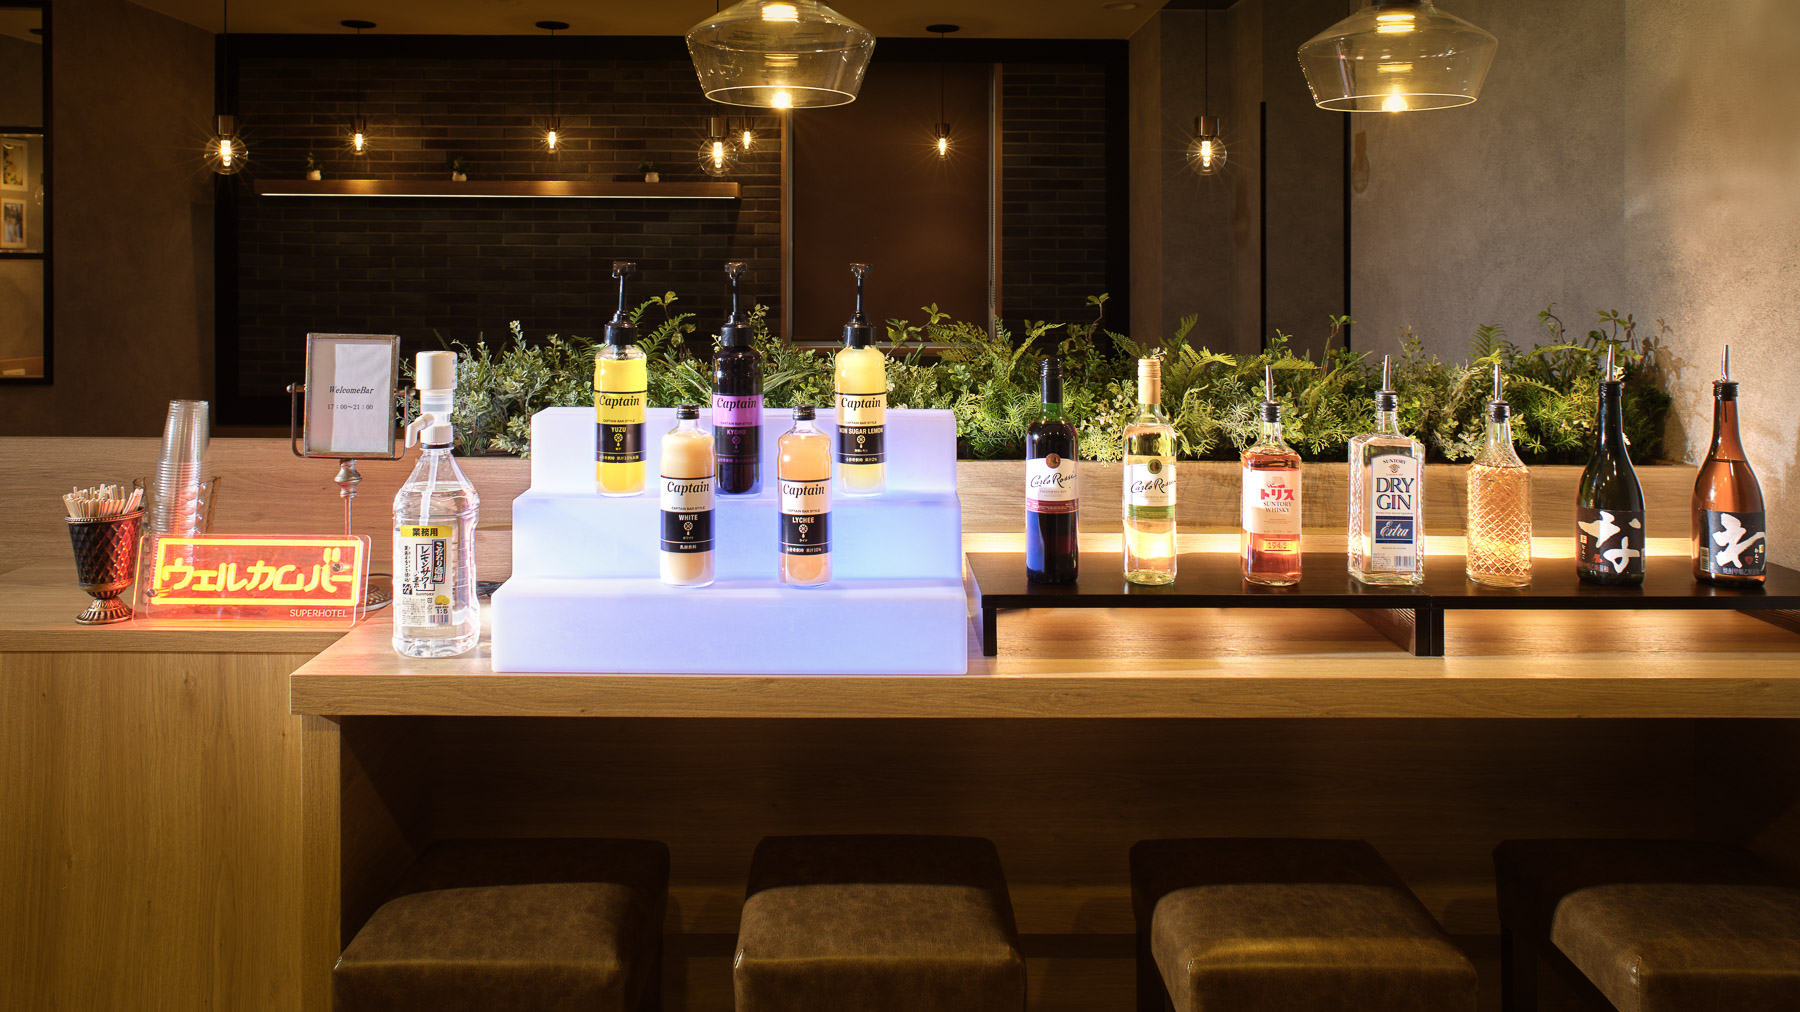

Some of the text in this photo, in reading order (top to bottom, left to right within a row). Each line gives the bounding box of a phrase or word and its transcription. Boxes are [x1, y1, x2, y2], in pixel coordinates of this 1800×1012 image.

[329, 386, 374, 394] WelcomeBar
[599, 395, 640, 409] Captain
[716, 398, 757, 411] Captain
[841, 398, 881, 411] Captain
[1030, 470, 1077, 489] Carlo Rossi
[1376, 477, 1415, 494] DRY
[667, 481, 709, 496] Captain
[783, 484, 824, 498] Captain
[1130, 480, 1153, 494] Carlo
[1260, 488, 1295, 501] トリス
[1376, 494, 1412, 510] GIN
[413, 527, 439, 537] 業務用
[1379, 520, 1410, 539] Extra
[1578, 511, 1641, 574] な
[162, 547, 352, 592] ウェルカムバー
[289, 609, 348, 618] SUPERHOTEL
